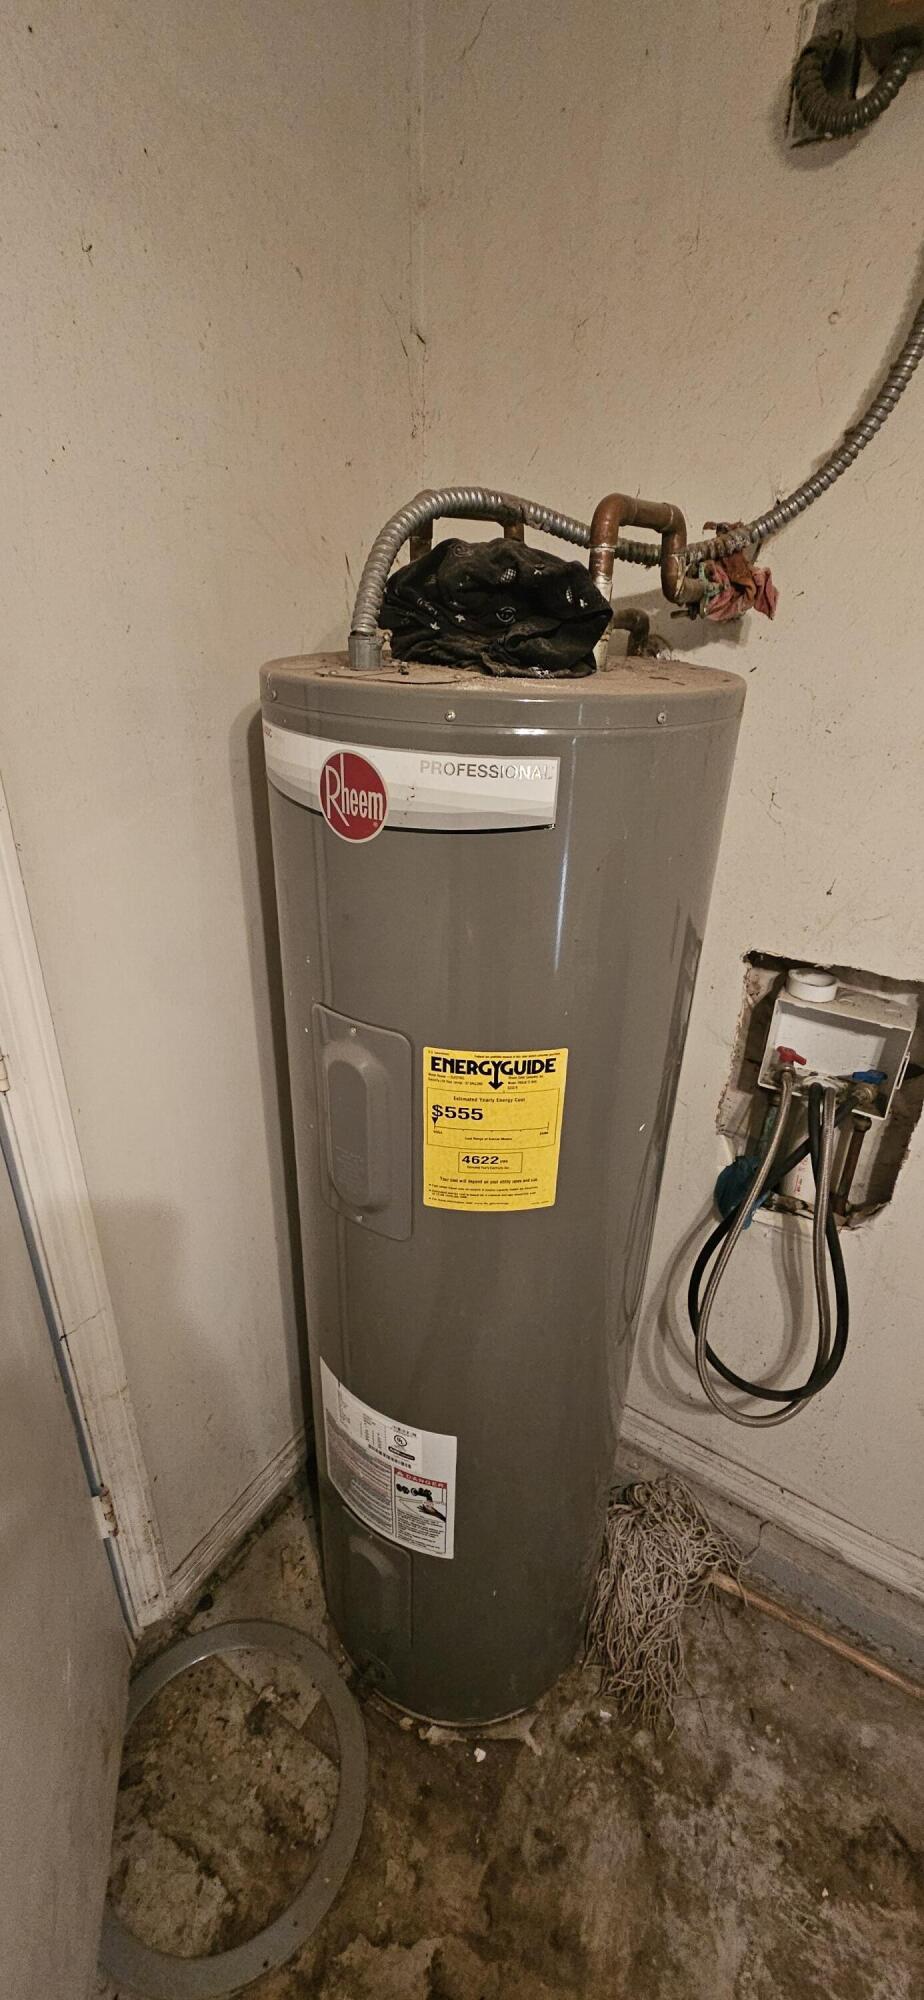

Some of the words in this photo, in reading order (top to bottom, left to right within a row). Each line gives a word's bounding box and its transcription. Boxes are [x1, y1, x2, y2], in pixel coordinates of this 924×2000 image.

[420, 760, 552, 780] PROFESSIONAL
[325, 753, 384, 827] Rheem
[431, 1056, 556, 1077] ENERGYGUIDE
[453, 1095, 477, 1103] Estimated
[431, 1104, 484, 1121] $555
[461, 1155, 499, 1165] 4622
